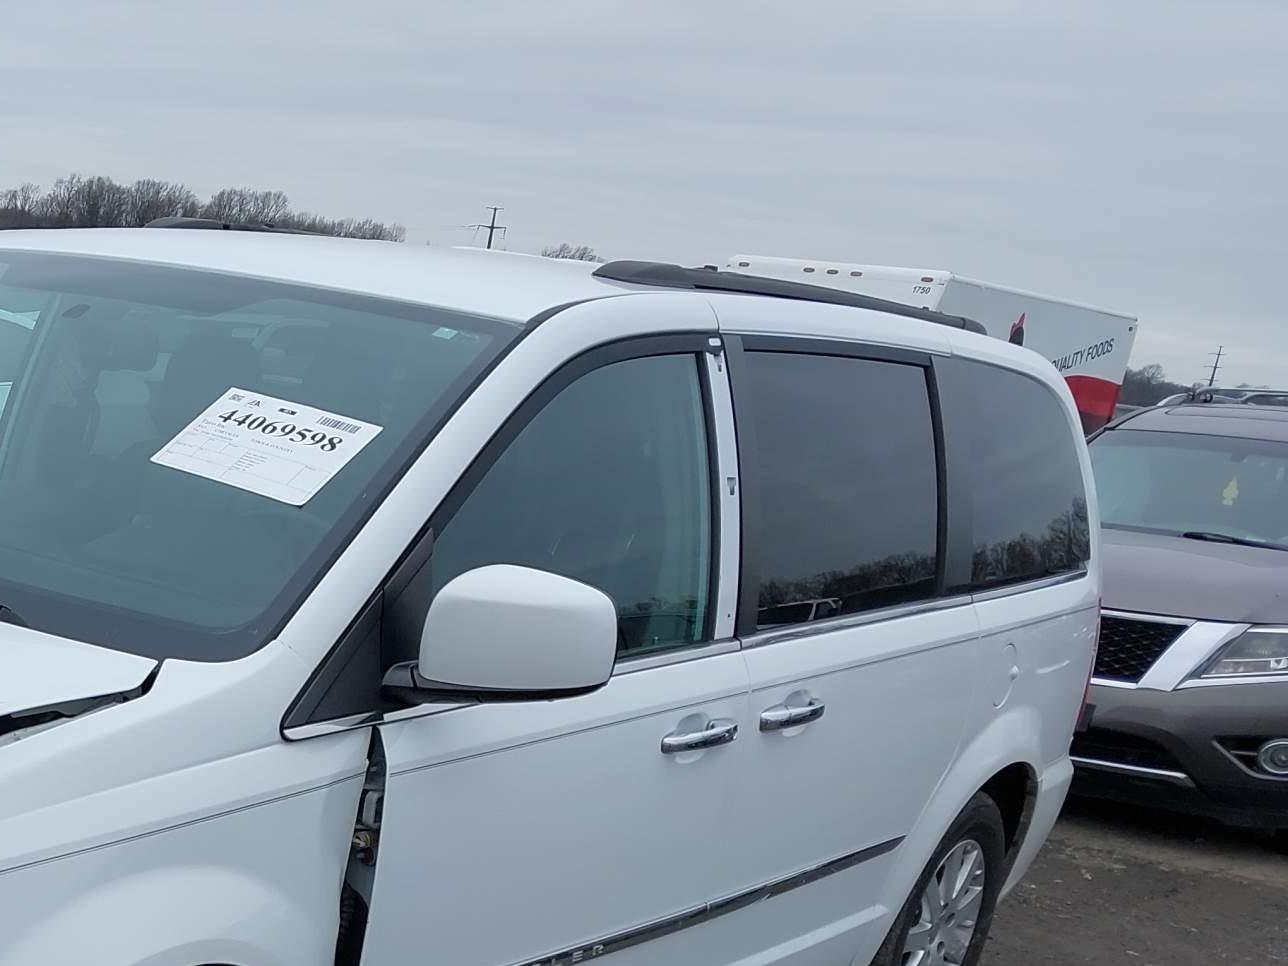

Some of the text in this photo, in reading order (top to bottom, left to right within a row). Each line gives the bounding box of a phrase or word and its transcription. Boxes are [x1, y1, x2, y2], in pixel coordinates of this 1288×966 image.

[912, 286, 931, 294] 1750
[1085, 338, 1115, 362] FOODS
[218, 409, 344, 452] 44069598
